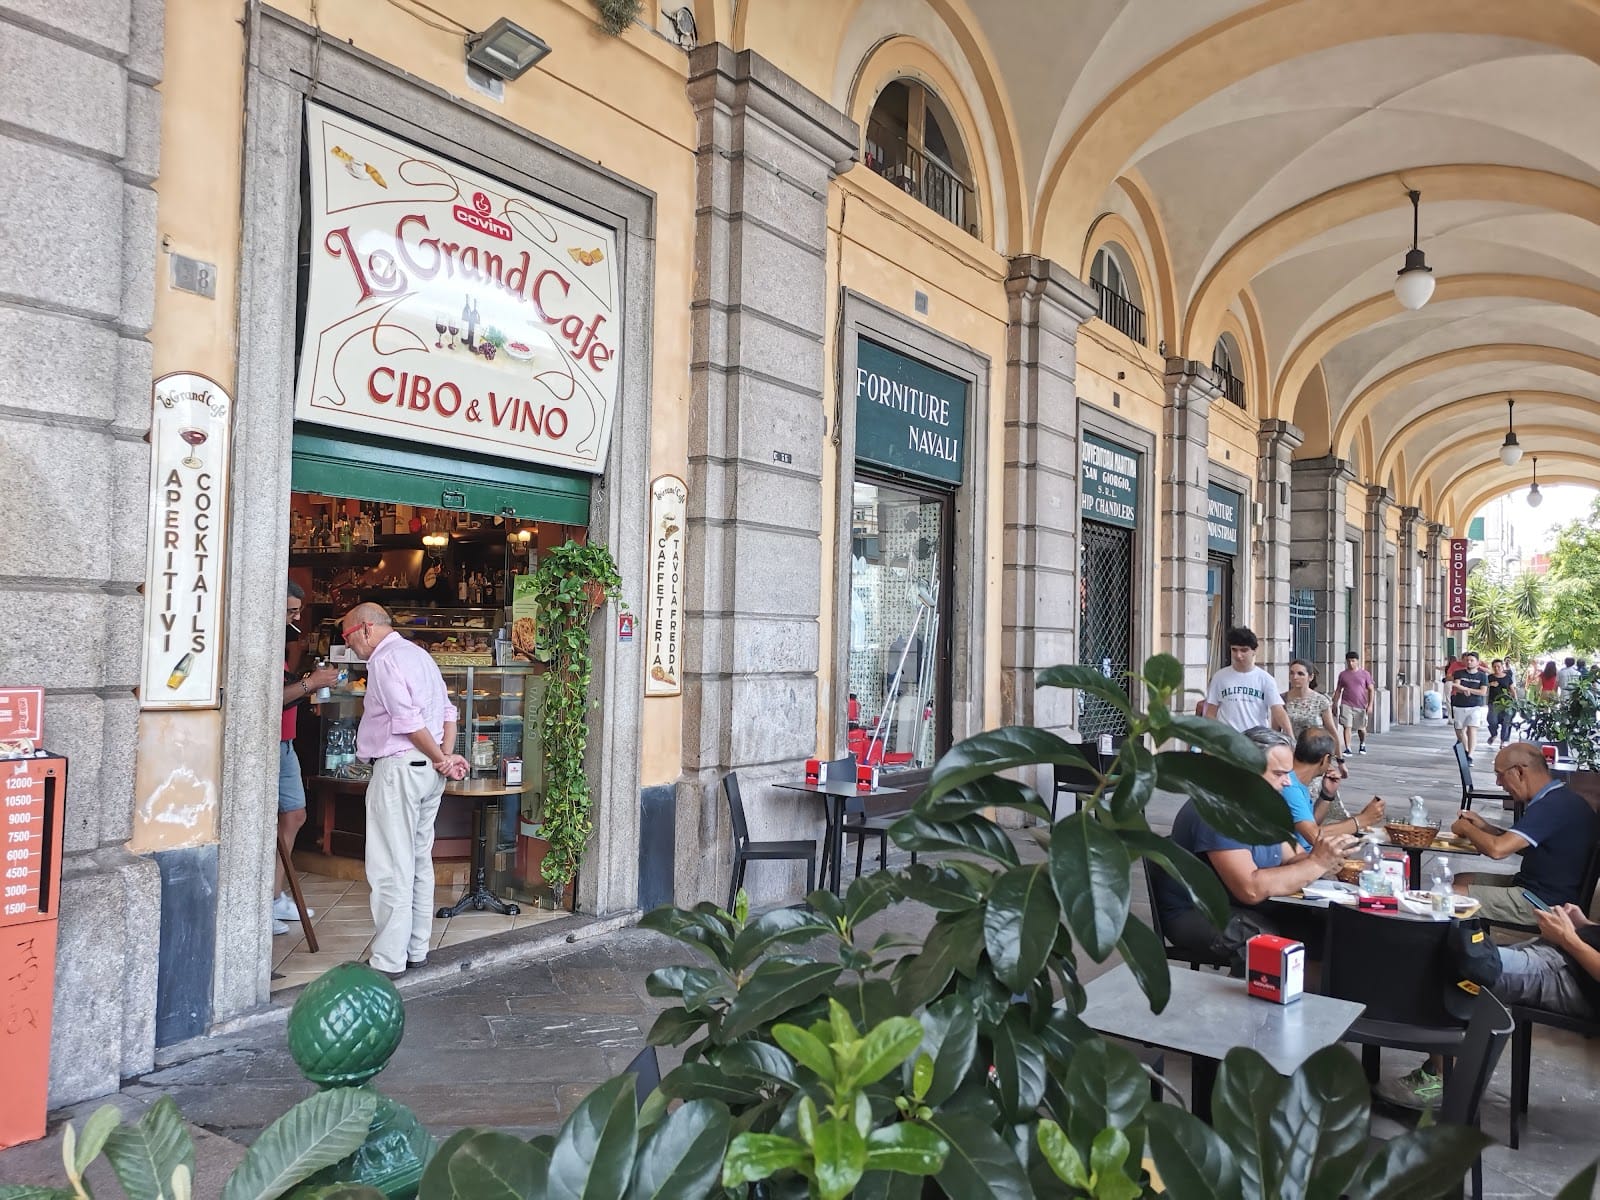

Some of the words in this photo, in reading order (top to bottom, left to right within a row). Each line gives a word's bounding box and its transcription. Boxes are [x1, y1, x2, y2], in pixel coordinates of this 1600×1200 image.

[457, 209, 511, 239] covim
[324, 226, 408, 307] Le
[395, 214, 530, 302] Grand
[368, 366, 462, 418] CIBO
[464, 399, 482, 423] &
[487, 391, 568, 440] VINO
[856, 367, 950, 427] FORNITURE
[908, 425, 958, 462] NAVALI
[1095, 498, 1134, 521] CHANDLERS
[160, 469, 183, 653] APERITIVI
[191, 473, 212, 653] COCKTAILS
[670, 539, 680, 606] TAVOLA
[1454, 553, 1463, 595] BOLLO
[653, 538, 666, 666] CAFFETTERIA
[668, 609, 678, 676] FREDDA
[6, 777, 32, 789] 12000
[5, 794, 31, 807] 10500
[8, 812, 31, 825] 9000
[8, 830, 30, 843] 7500
[6, 848, 29, 861] 6000
[6, 866, 28, 879] 4500
[5, 884, 27, 897] 3000
[4, 902, 26, 915] 1500
